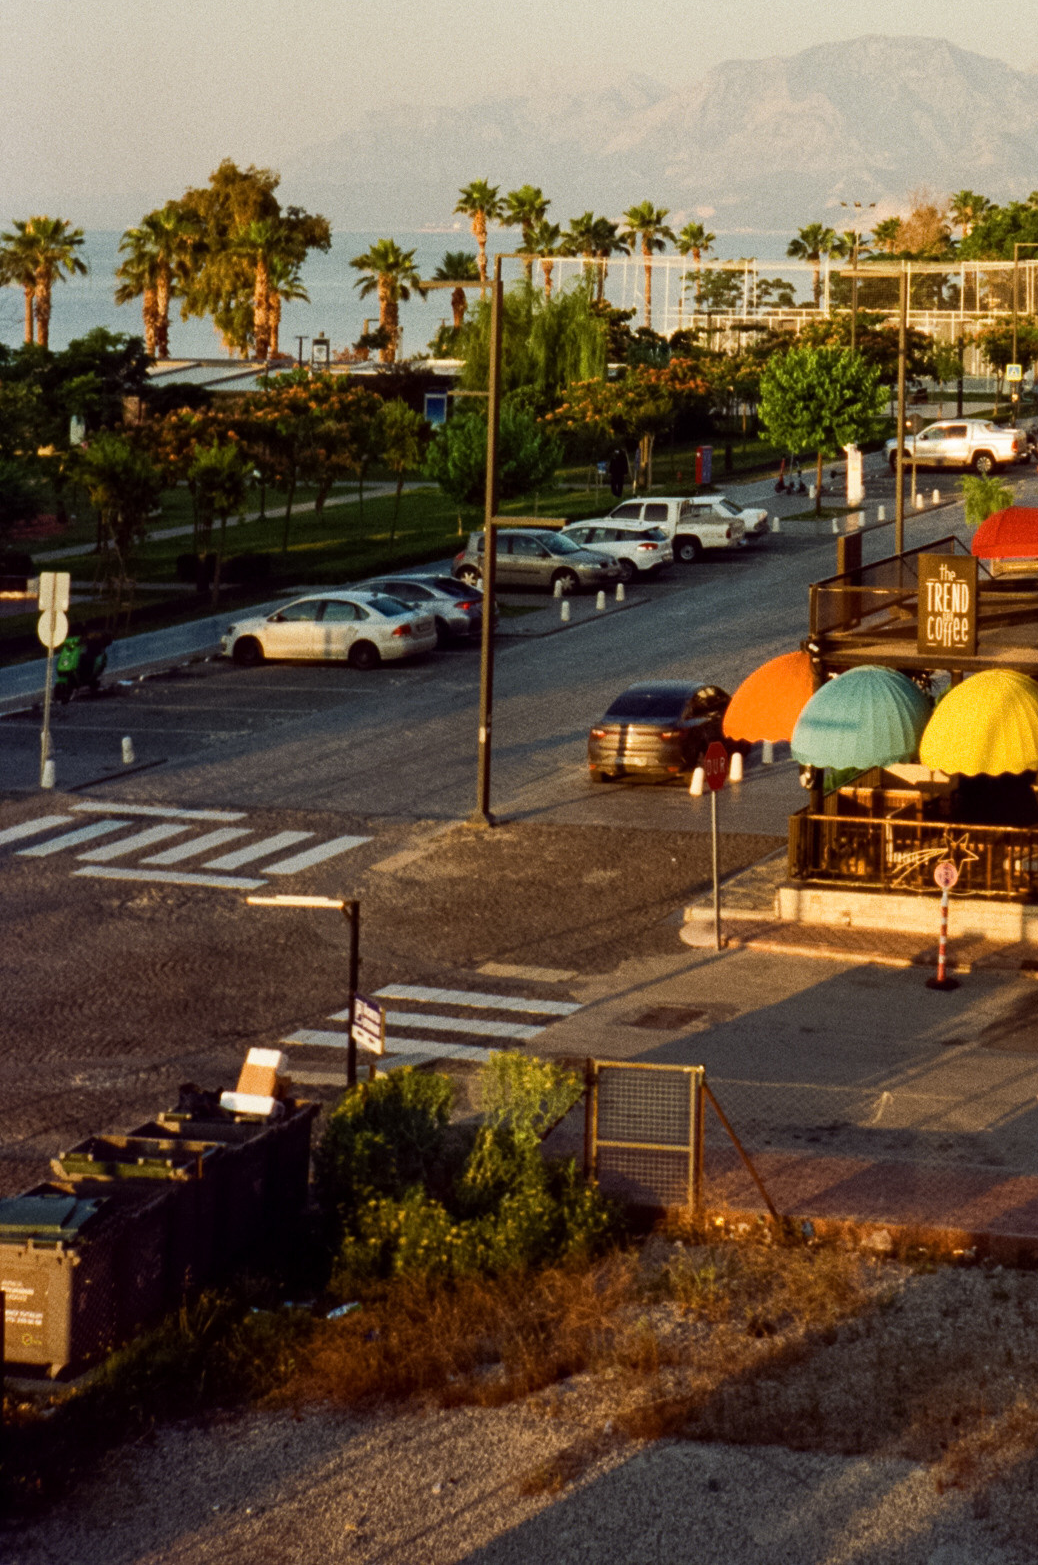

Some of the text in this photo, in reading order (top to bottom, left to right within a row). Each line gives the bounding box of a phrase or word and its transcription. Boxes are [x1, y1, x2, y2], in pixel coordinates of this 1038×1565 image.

[938, 563, 957, 581] the
[925, 582, 969, 613] TREND
[706, 757, 726, 776] DUR
